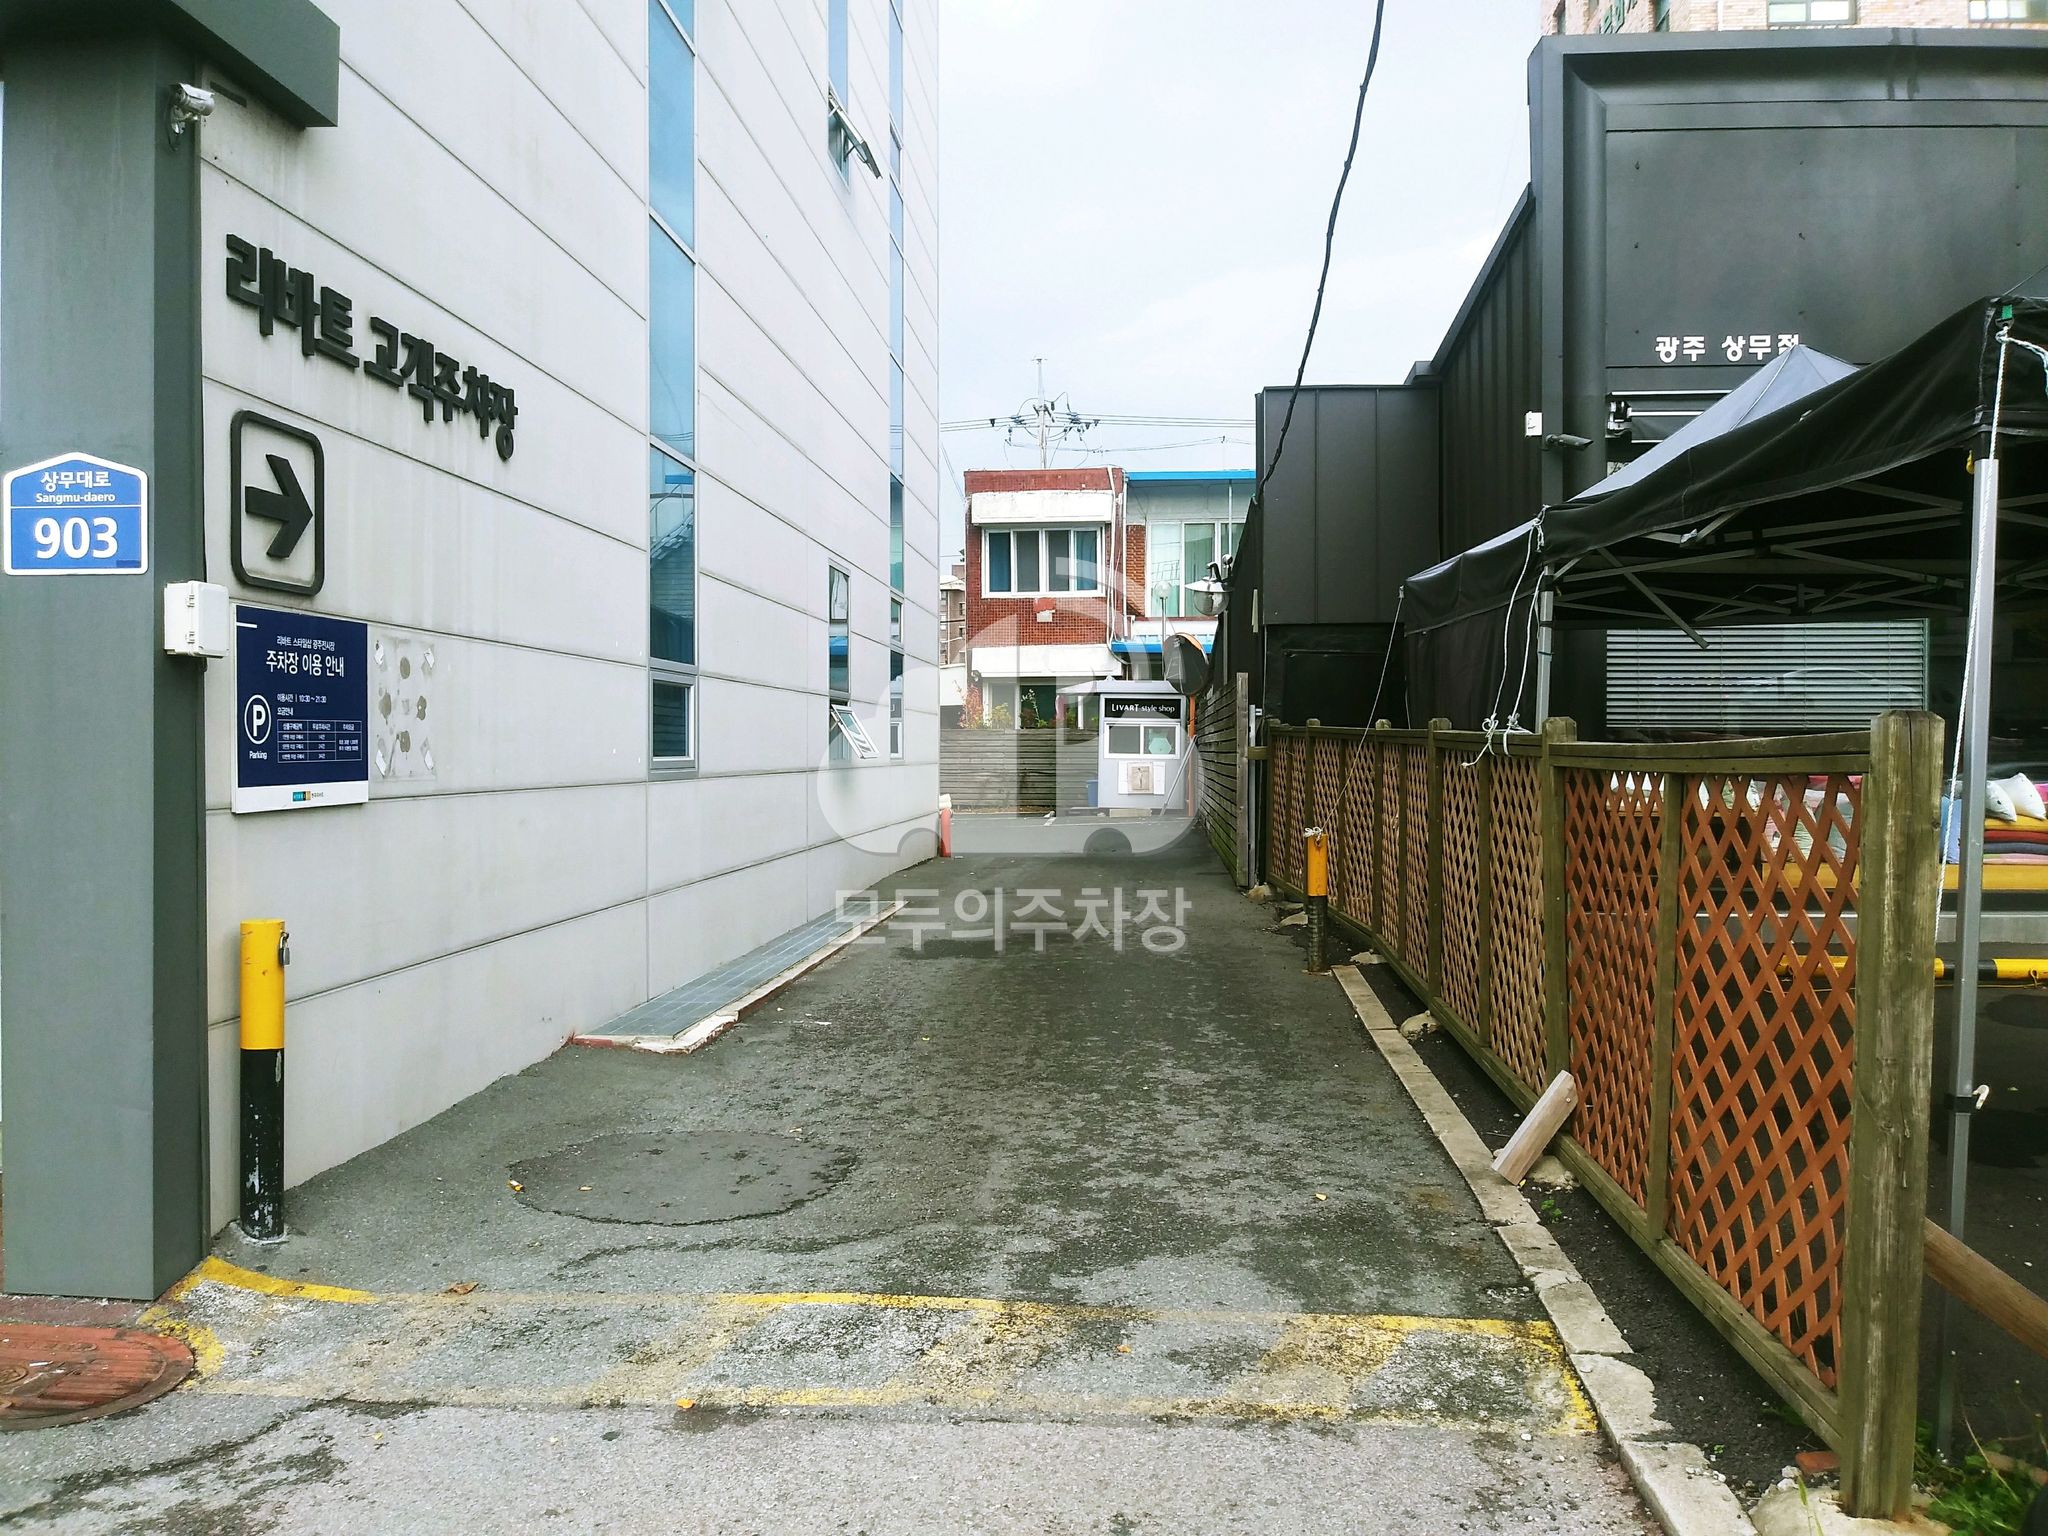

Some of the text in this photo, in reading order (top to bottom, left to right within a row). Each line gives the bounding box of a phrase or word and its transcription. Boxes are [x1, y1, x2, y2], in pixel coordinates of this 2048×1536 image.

[226, 234, 519, 460] 리바트 고객주차장
[1655, 336, 1706, 363] 광주
[40, 470, 112, 493] 상무대로
[35, 492, 116, 505] Sangmu-daero
[34, 517, 118, 560] 903
[276, 635, 292, 647] 리바트
[265, 649, 344, 678] 주차장 이용 안내
[252, 704, 266, 737] P
[1111, 703, 1139, 712] LIVART
[1158, 704, 1176, 714] shop
[249, 750, 268, 760] Parking
